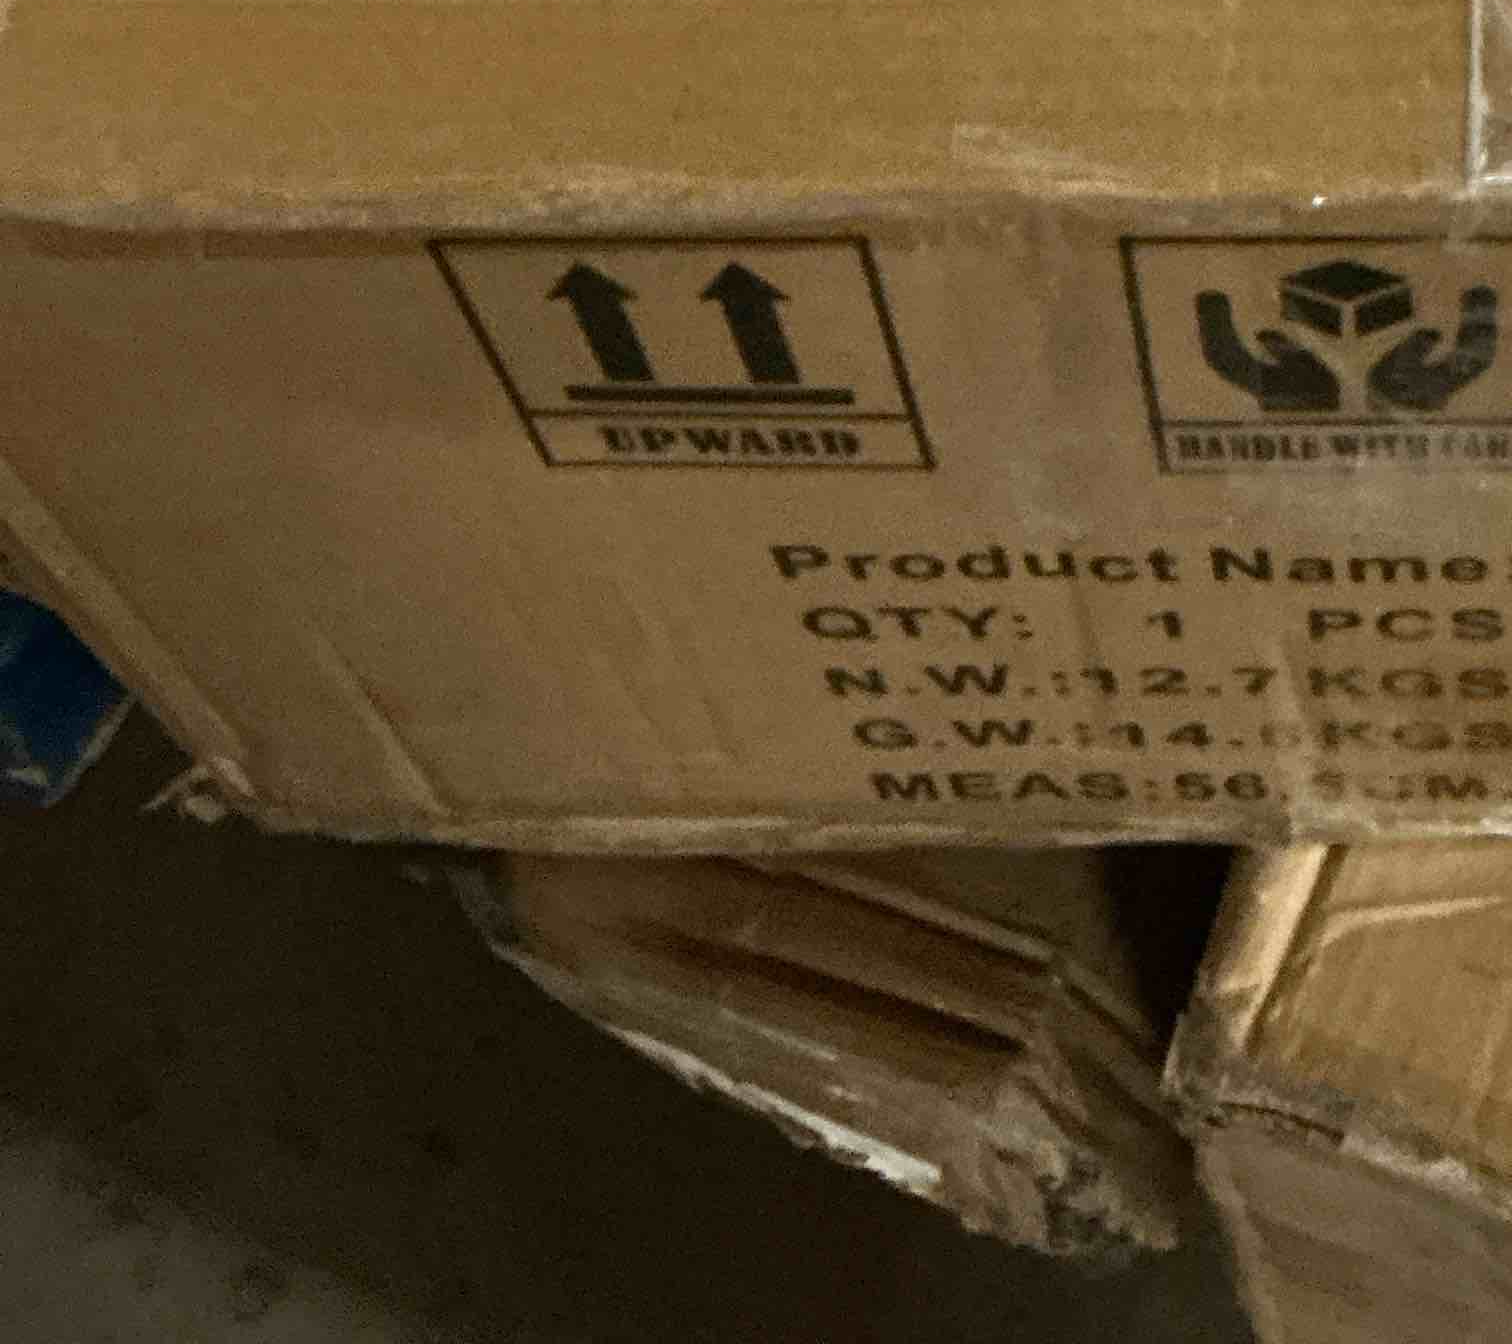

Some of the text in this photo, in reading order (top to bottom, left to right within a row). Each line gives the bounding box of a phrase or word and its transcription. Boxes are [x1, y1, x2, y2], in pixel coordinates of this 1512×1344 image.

[600, 424, 863, 457] UPWARD
[1177, 433, 1322, 462] HANDLE
[1328, 433, 1430, 462] WITH
[770, 543, 1181, 583] Product
[801, 605, 1505, 642] QTY: 1 PCS
